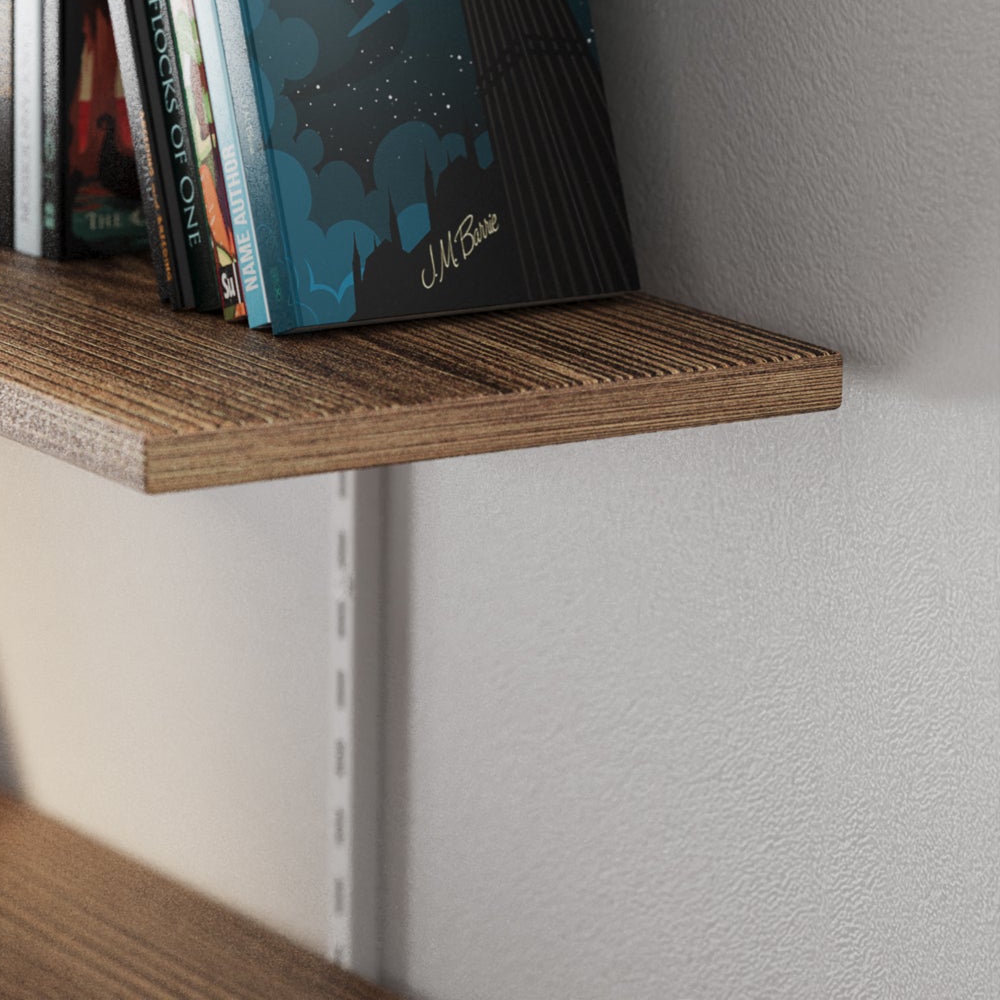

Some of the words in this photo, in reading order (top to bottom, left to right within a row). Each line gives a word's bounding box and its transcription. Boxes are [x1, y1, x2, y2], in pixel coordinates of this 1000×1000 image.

[170, 122, 188, 165] OF
[178, 174, 203, 248] ONE
[218, 142, 249, 227] AUTHOR
[235, 227, 259, 293] NAME
[453, 212, 500, 261] Barrie
